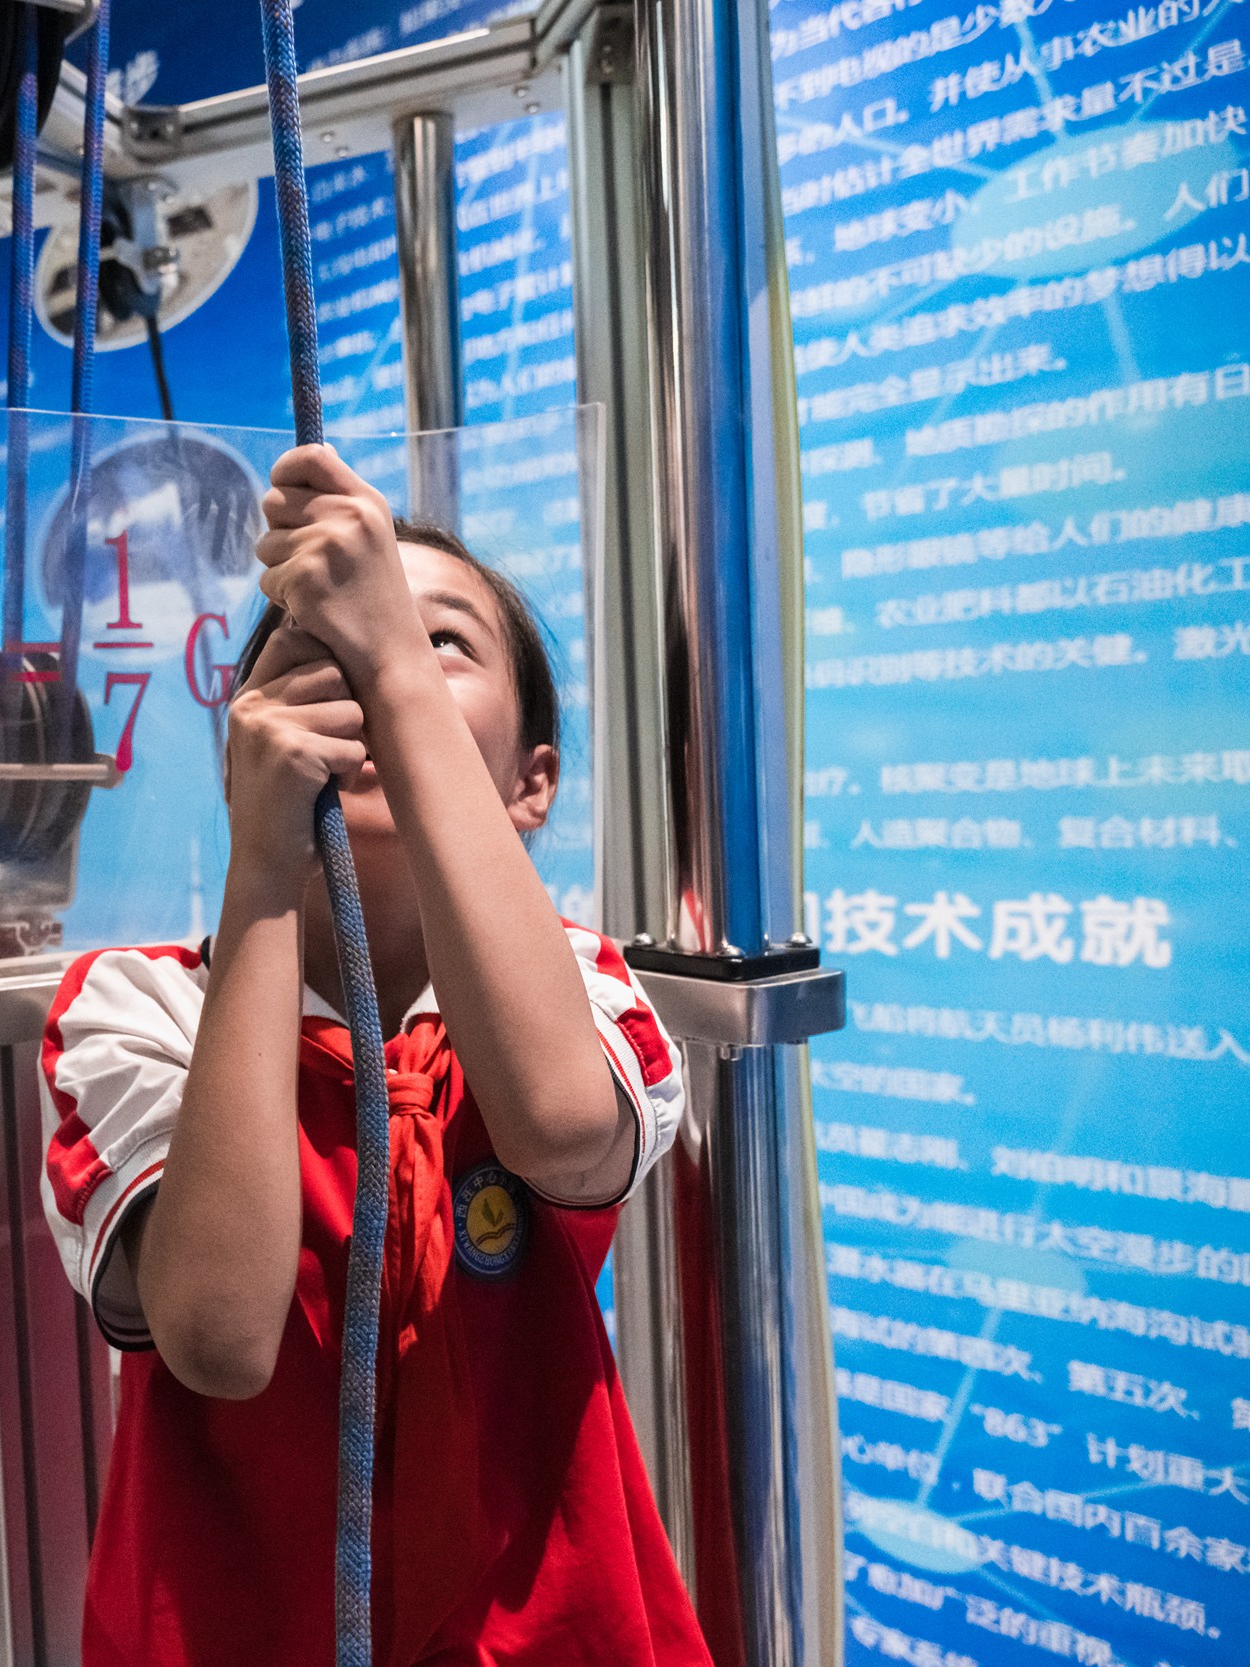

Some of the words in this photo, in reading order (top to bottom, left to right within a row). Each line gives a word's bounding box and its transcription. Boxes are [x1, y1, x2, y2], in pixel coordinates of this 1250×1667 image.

[106, 530, 143, 630] 1
[186, 613, 240, 708] G
[104, 673, 151, 772] 7
